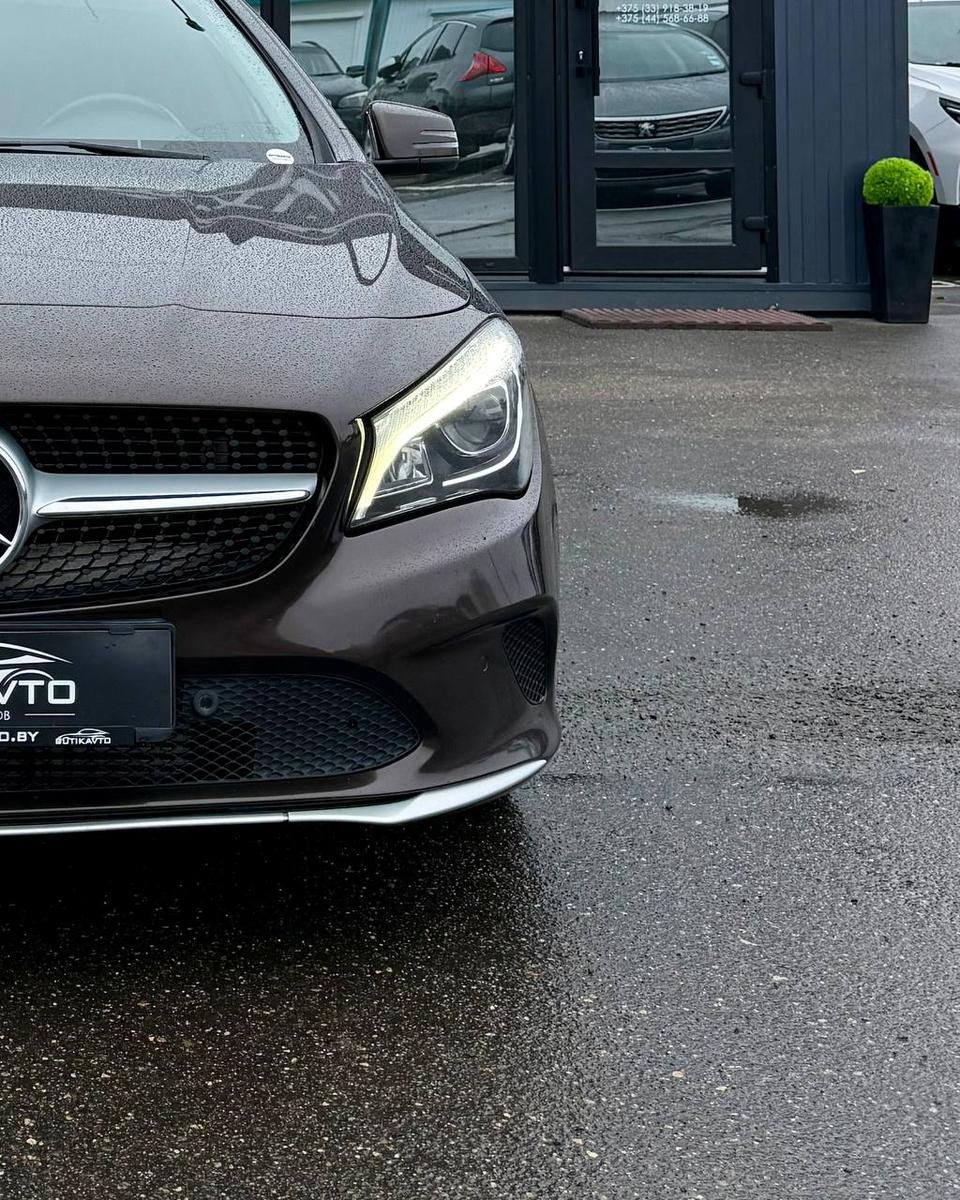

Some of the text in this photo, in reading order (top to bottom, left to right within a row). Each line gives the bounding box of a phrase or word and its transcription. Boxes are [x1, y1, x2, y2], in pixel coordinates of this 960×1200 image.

[616, 3, 709, 14] +375 (33) 918-38-19
[616, 13, 709, 24] +375 (44) 568-66-88
[55, 736, 112, 746] BUTIKAVTO
